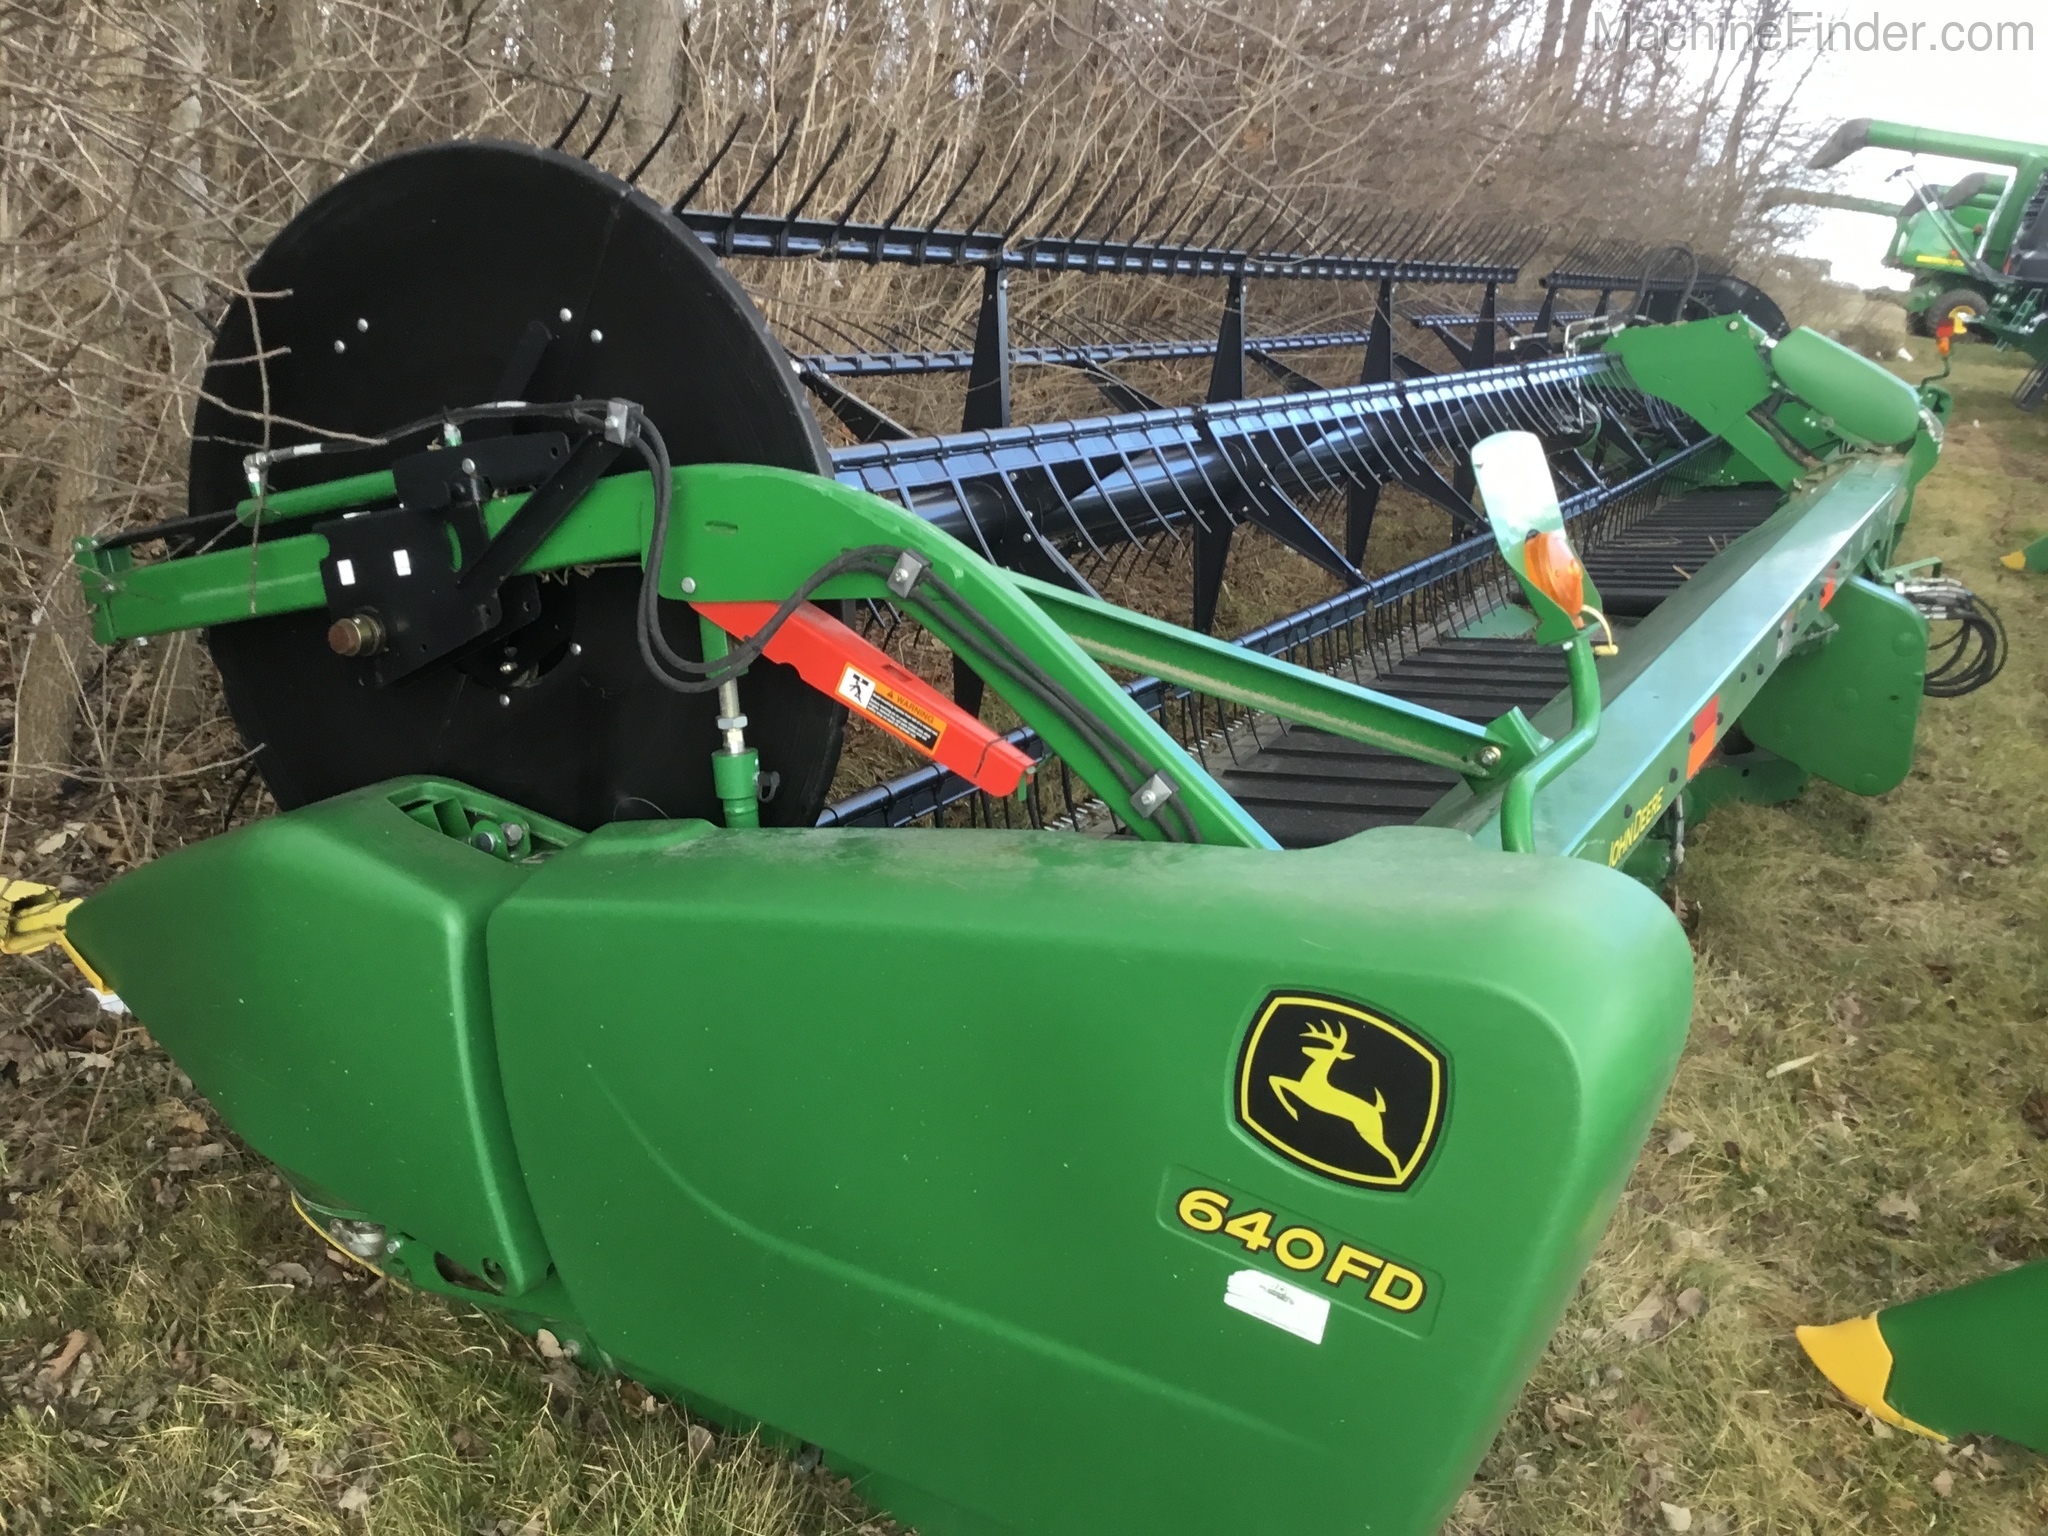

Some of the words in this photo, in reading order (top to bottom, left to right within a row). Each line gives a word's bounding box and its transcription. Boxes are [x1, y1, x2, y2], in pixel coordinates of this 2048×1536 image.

[896, 695, 935, 724] WARNING
[1609, 822, 1634, 868] JOHN
[1633, 786, 1664, 842] DEERE
